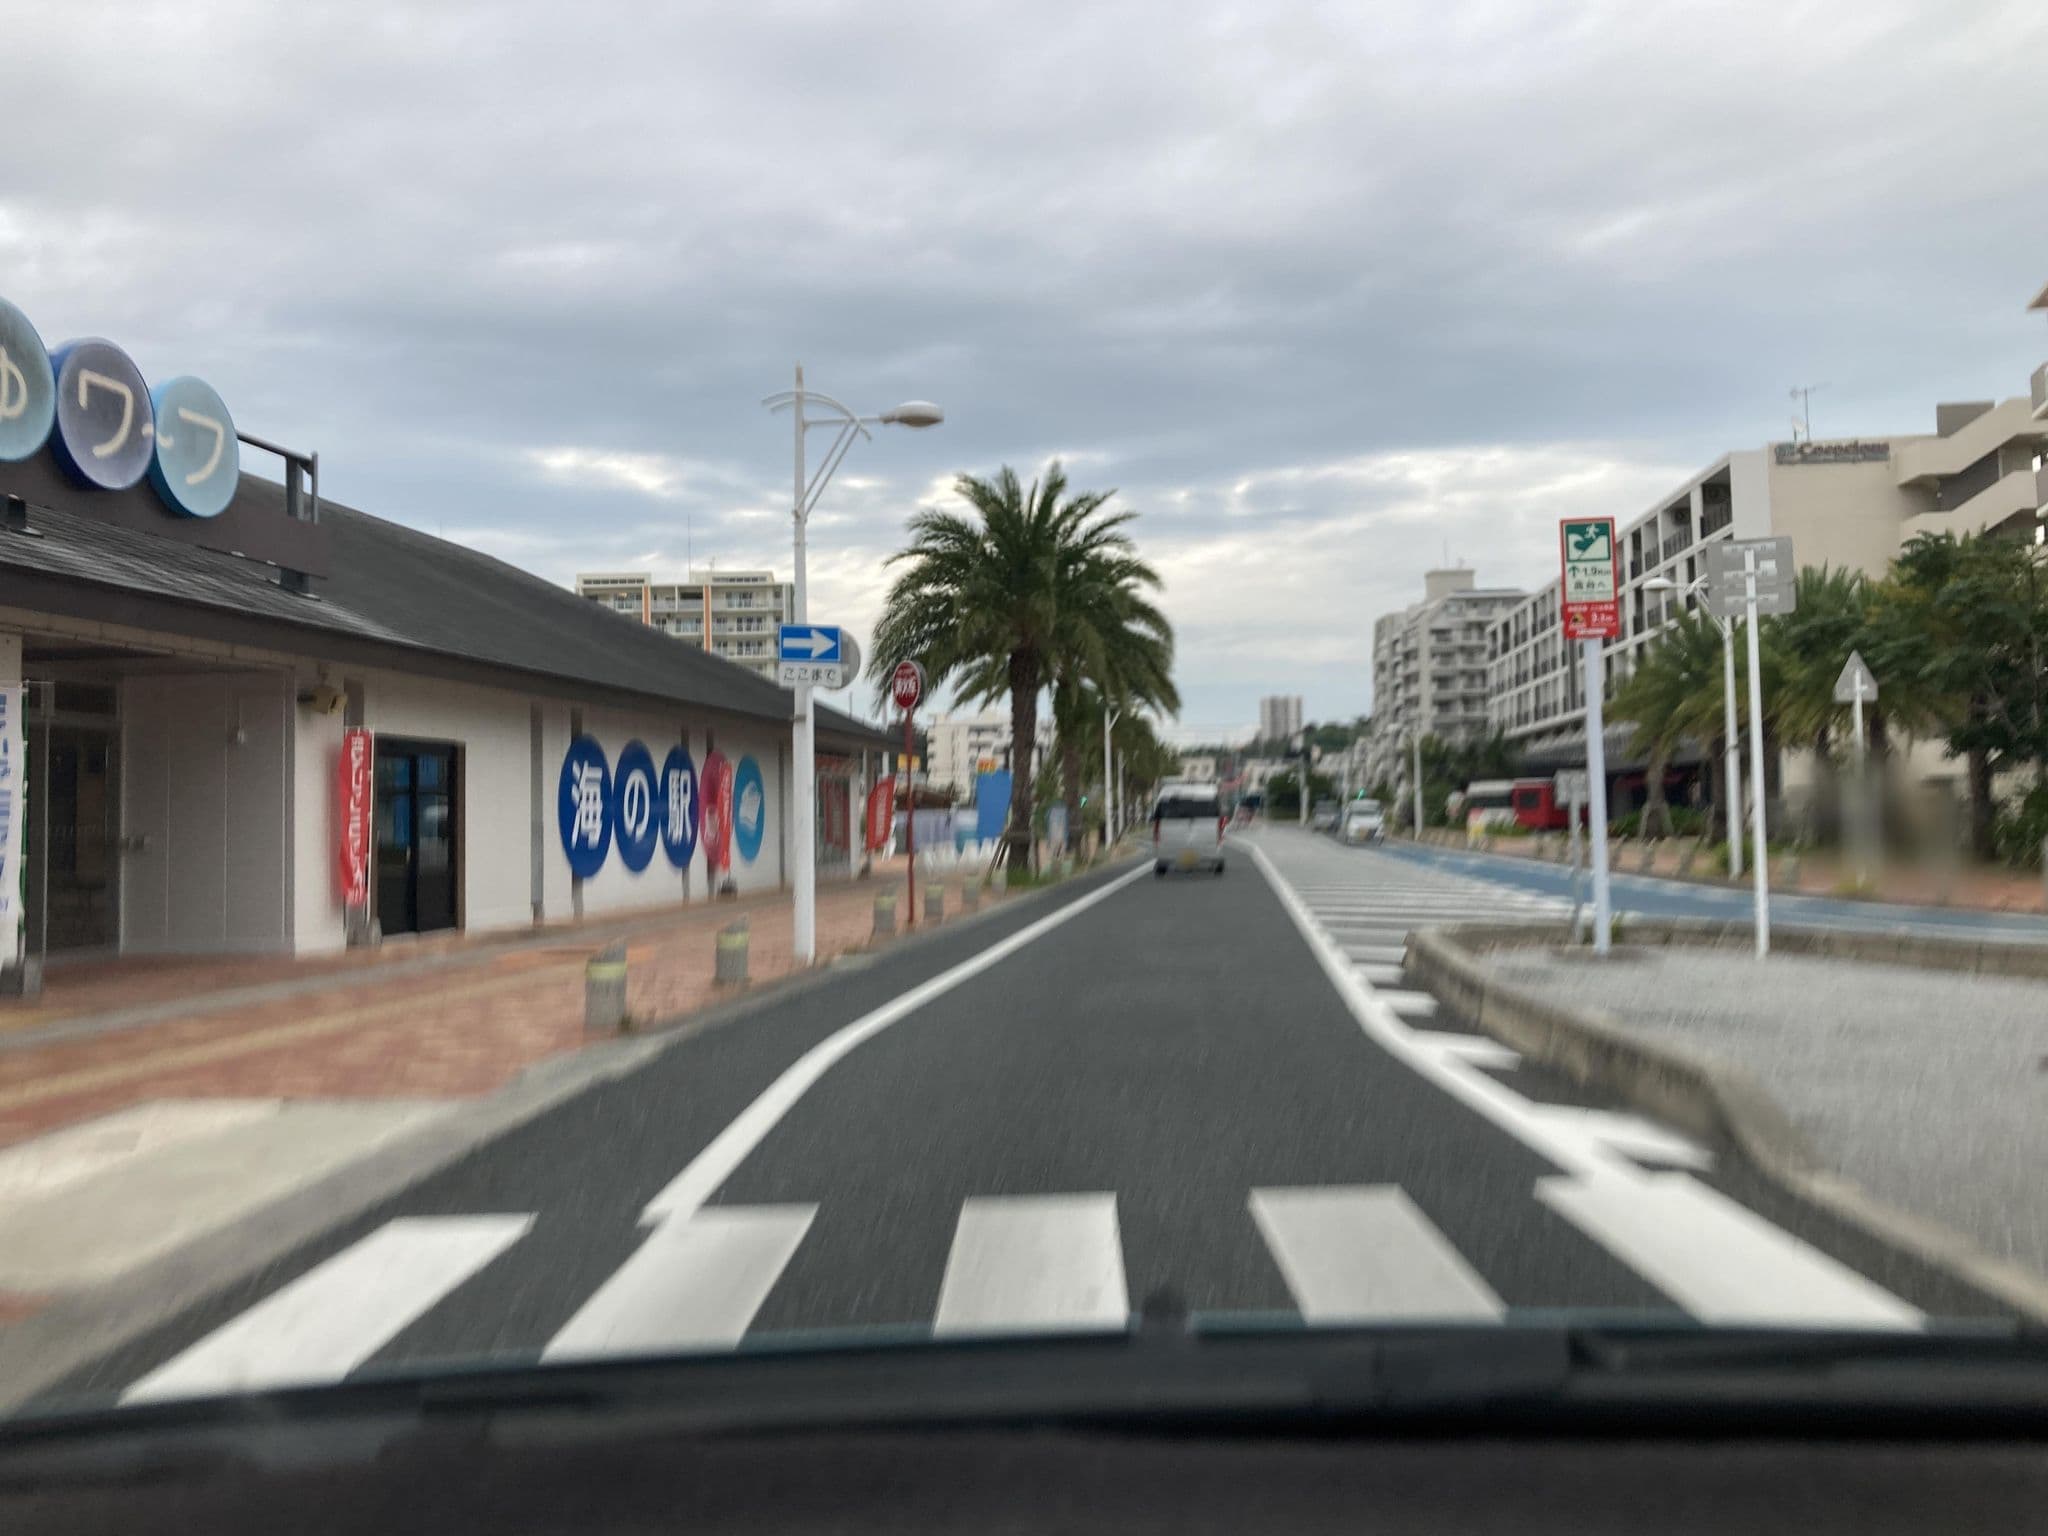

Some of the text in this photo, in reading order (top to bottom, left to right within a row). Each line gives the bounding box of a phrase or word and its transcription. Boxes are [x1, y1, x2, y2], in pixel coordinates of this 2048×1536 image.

[784, 667, 836, 681] ここまで
[571, 760, 693, 849] 海の駅
